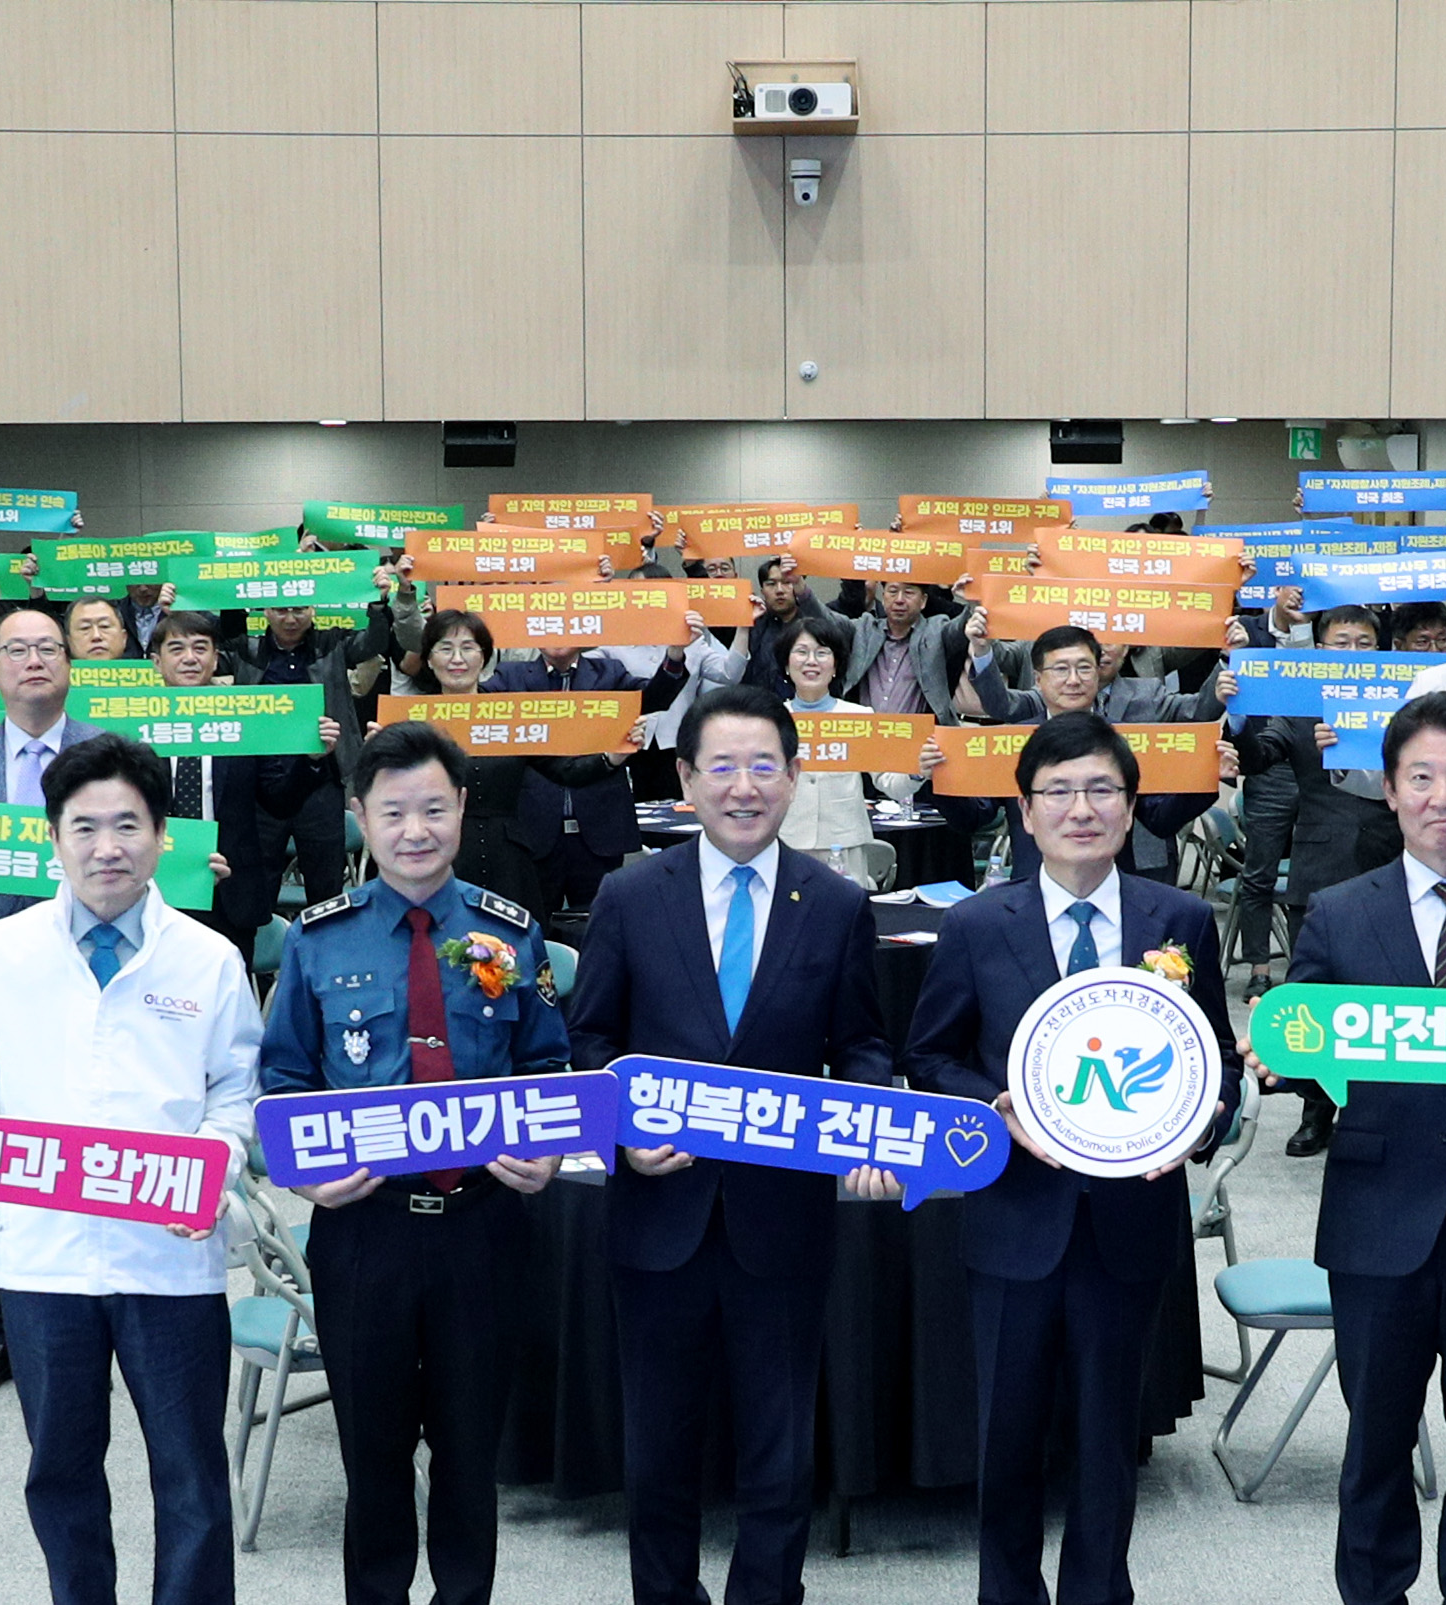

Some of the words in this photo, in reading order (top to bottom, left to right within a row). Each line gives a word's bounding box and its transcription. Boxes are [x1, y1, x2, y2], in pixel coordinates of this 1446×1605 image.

[507, 501, 518, 512] 섬
[522, 500, 545, 512] 지역
[549, 500, 572, 512] 치안
[571, 500, 611, 512] 인프라
[614, 500, 637, 512] 구축
[546, 516, 570, 531] 전국
[573, 516, 594, 528] 1위
[56, 544, 107, 563] 교통분야
[110, 540, 194, 557] 지역안전지수
[87, 562, 124, 577] 1등급
[128, 561, 158, 575] 상향
[198, 562, 260, 579] 교통분야
[264, 558, 355, 576] 지역안전지수
[236, 581, 278, 598] 1등급
[282, 580, 315, 596] 상향
[1009, 585, 1026, 603] 섬
[1035, 586, 1069, 605] 지역
[1074, 588, 1111, 606] 치안
[1117, 589, 1171, 609] 인프라
[1176, 592, 1212, 611] 구축
[465, 594, 483, 612] 섬
[489, 593, 524, 611] 지역
[530, 593, 567, 610] 치안
[572, 591, 626, 610] 인프라
[632, 590, 667, 608] 구축
[527, 617, 564, 635] 전국
[570, 616, 601, 634] 1위
[1069, 611, 1107, 631] 전국
[1112, 613, 1144, 632] 1위
[89, 697, 170, 718] 교통분야
[176, 695, 294, 716] 지역안전지수
[408, 704, 427, 721] 섬
[433, 703, 470, 720] 지역
[477, 701, 514, 719] 치안
[521, 700, 576, 718] 인프라
[582, 700, 618, 718] 구축
[139, 723, 193, 743] 1등급
[199, 721, 241, 742] 상향
[470, 725, 509, 744] 전국
[515, 724, 548, 742] 1위
[1046, 988, 1197, 1052] 전라남도자치경찰위원회
[628, 1072, 806, 1150] 행복한
[816, 1096, 936, 1167] 전남
[1051, 1117, 1123, 1154] Autonomous
[1125, 1130, 1164, 1154] Police
[1162, 1063, 1199, 1134] Commission
[289, 1088, 582, 1172] 만들어가는
[79, 1142, 206, 1215] 함께
